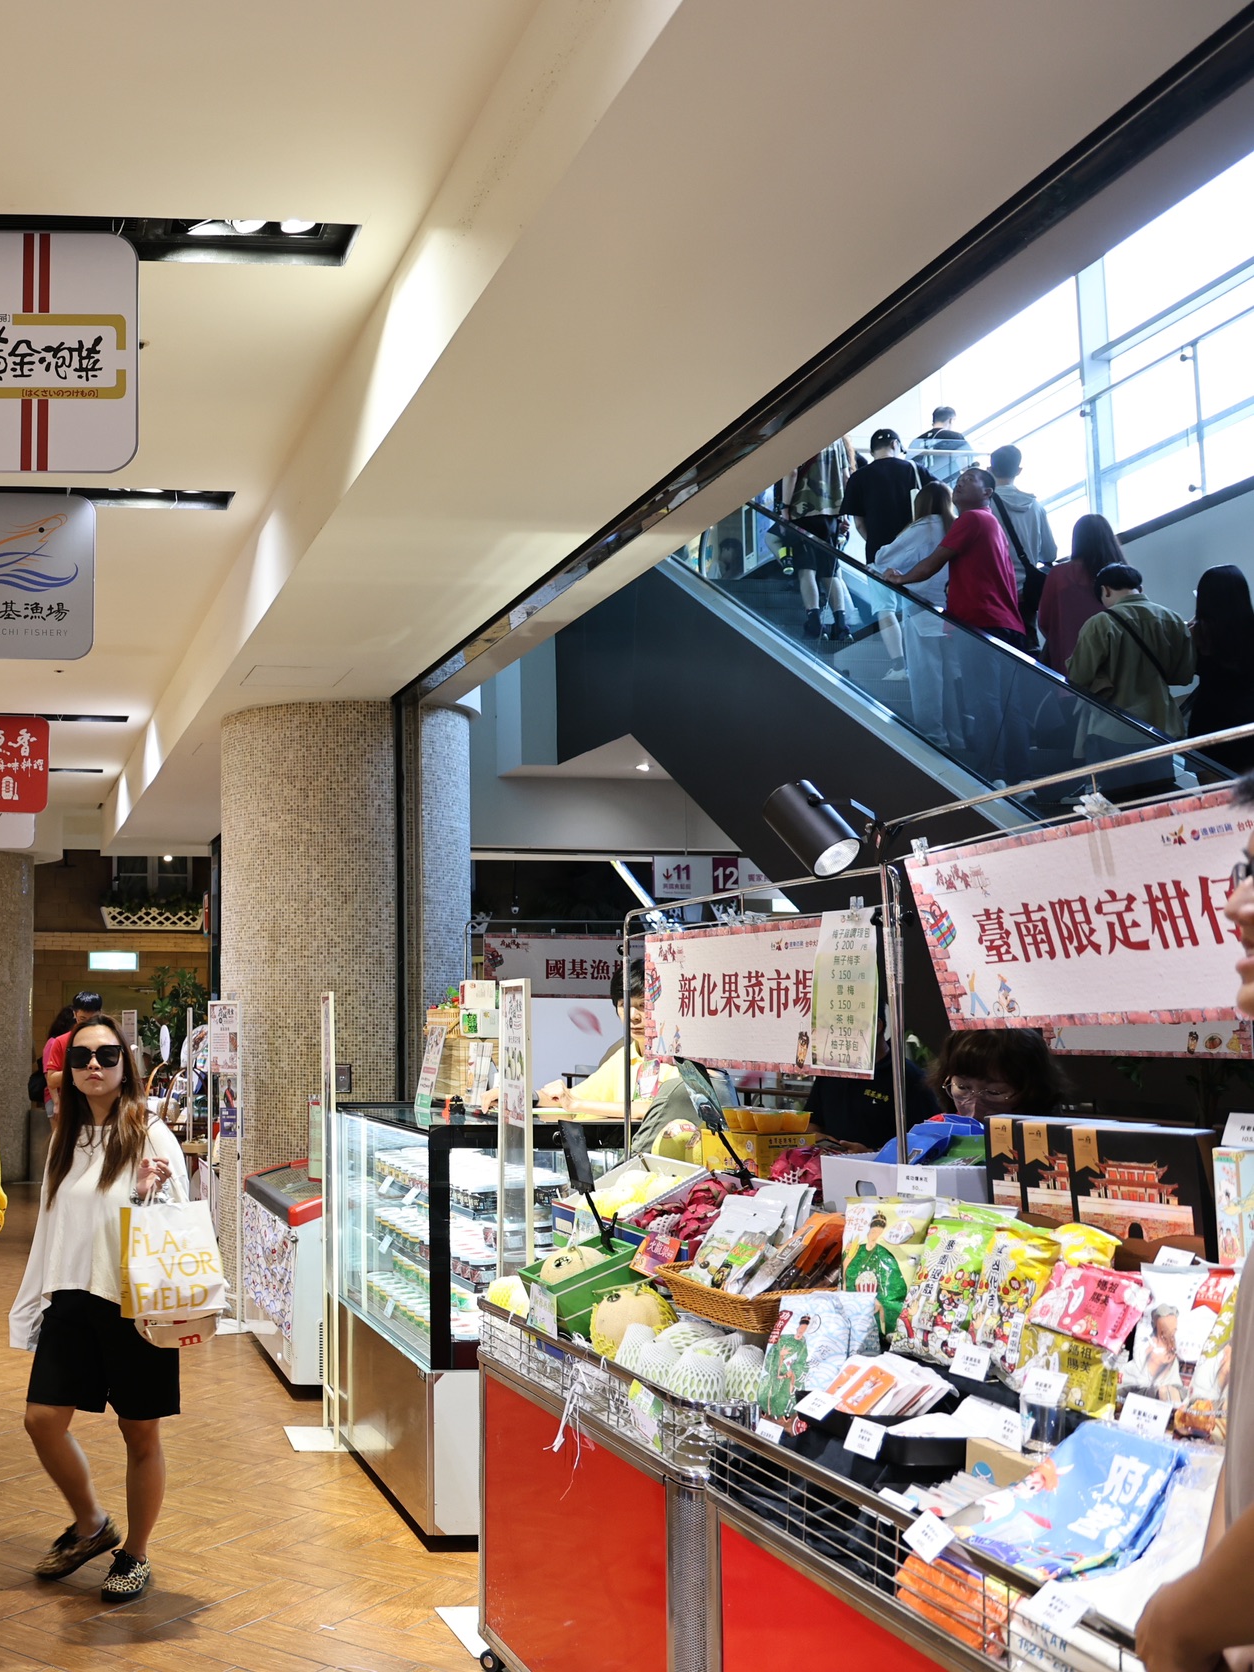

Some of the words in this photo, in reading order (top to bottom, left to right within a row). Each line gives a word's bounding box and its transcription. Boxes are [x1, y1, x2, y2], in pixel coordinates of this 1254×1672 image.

[24, 628, 68, 637] FISHERY
[673, 864, 691, 881] 11
[713, 867, 739, 889] 12
[841, 940, 854, 950] 200
[839, 970, 852, 980] 150
[677, 968, 814, 1019] 新化果菜市場
[838, 1000, 851, 1010] 150
[839, 1027, 852, 1037] 150
[838, 1053, 850, 1064] 170
[131, 1226, 182, 1258] FLA
[157, 1251, 219, 1280] VOR
[134, 1283, 209, 1314] FIELD
